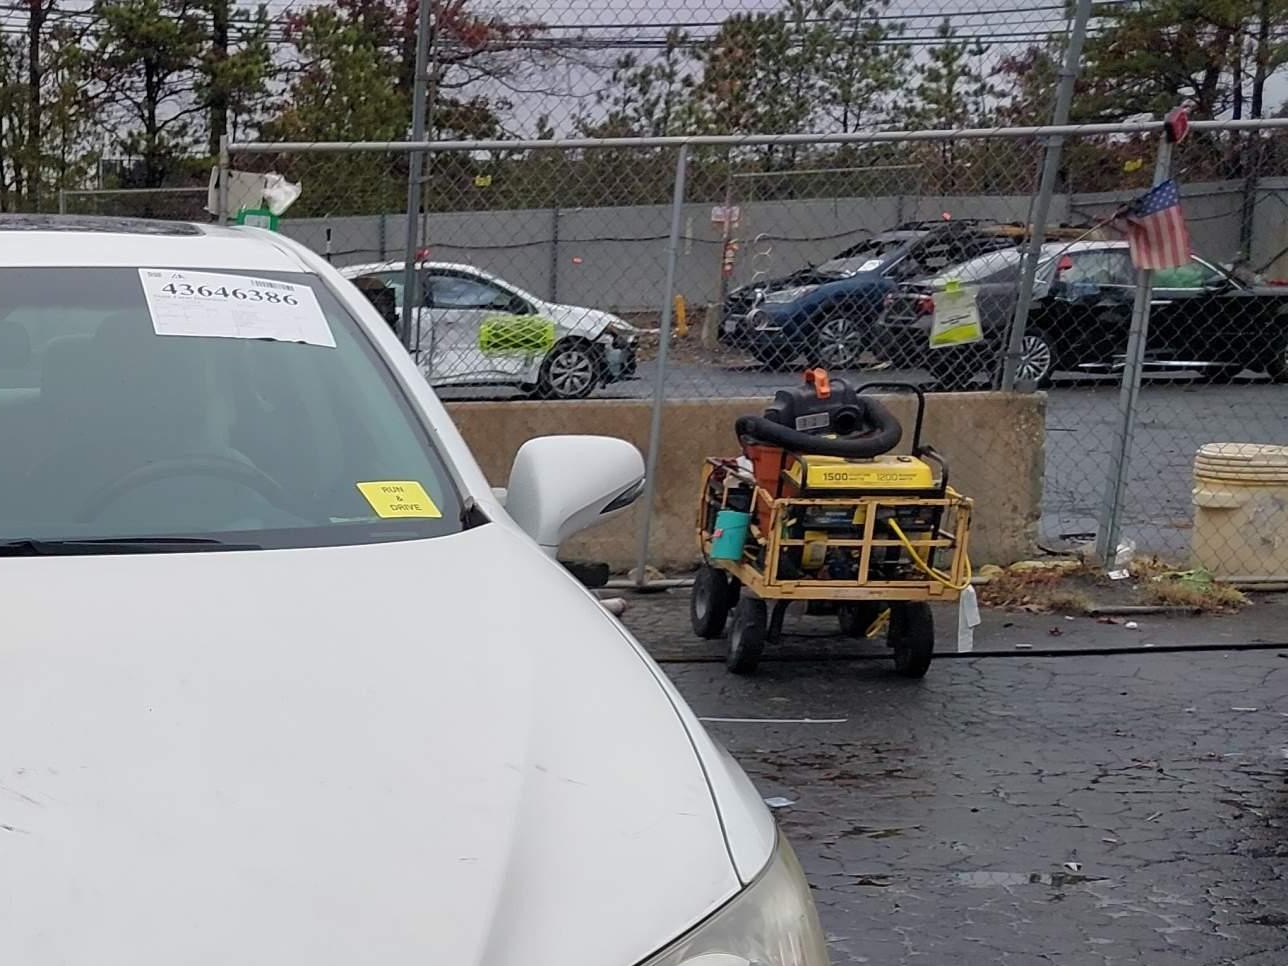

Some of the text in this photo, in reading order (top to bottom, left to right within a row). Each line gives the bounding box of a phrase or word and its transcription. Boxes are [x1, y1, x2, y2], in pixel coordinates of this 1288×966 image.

[161, 282, 299, 306] 43646386
[822, 472, 848, 481] 1500
[381, 486, 405, 494] RUN
[389, 503, 423, 511] DRIVE
